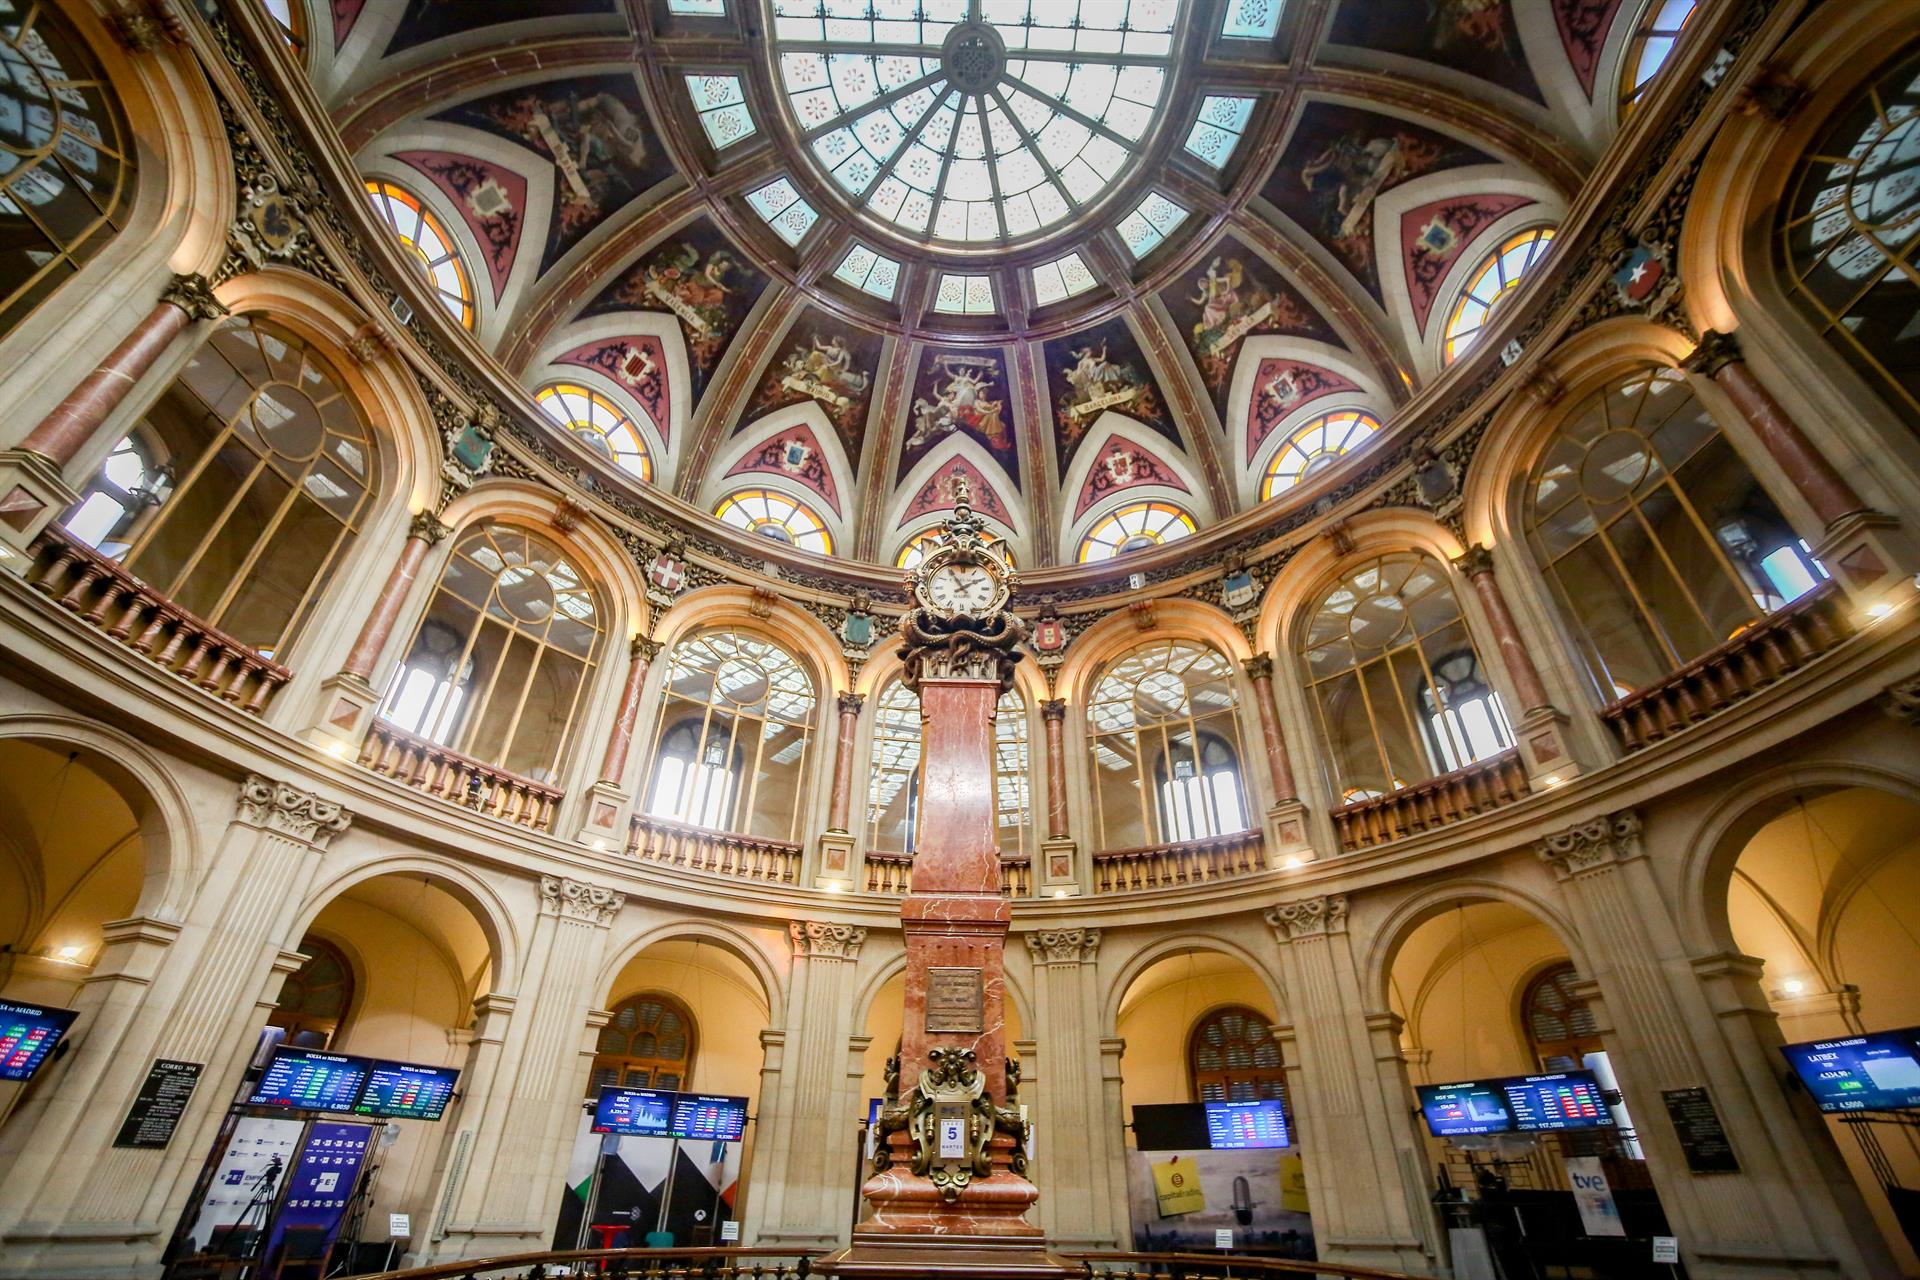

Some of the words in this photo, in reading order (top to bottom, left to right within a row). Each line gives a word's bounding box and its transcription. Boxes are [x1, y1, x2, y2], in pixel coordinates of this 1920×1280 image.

[1084, 395, 1122, 411] BARCELONA
[15, 1007, 42, 1016] MADRID
[1814, 1042, 1835, 1050] BOLSA
[1840, 1038, 1867, 1047] MADRID
[1807, 1052, 1840, 1063] LATIBEX
[301, 1100, 321, 1108] INDRA
[948, 1127, 957, 1140] 5
[1573, 1172, 1605, 1191] tve
